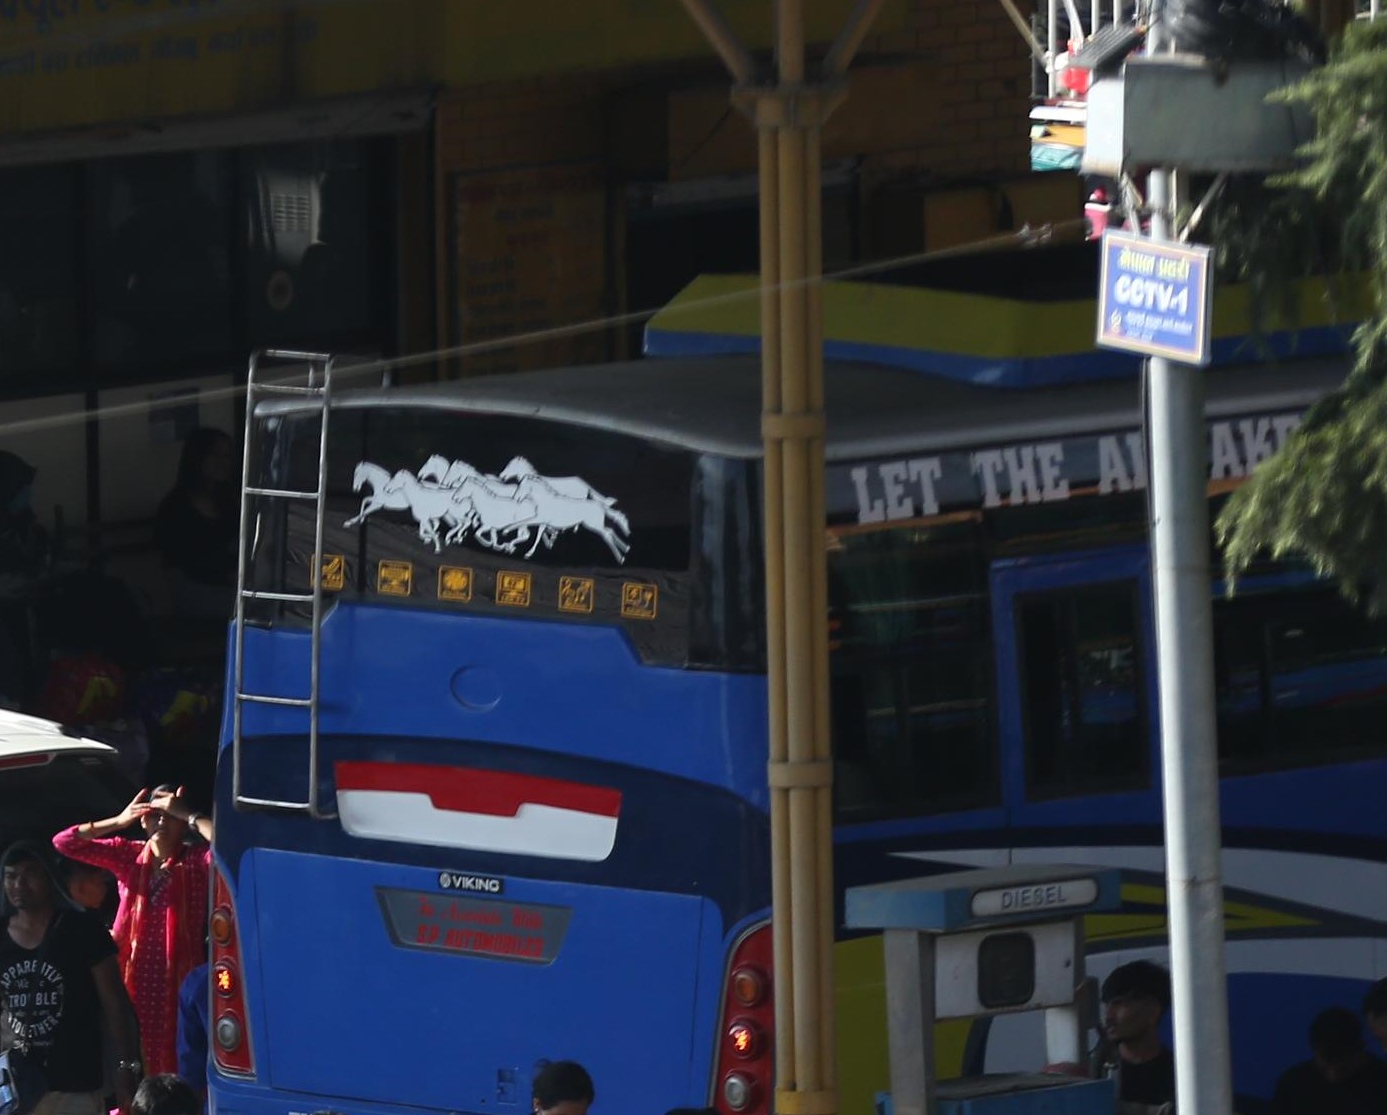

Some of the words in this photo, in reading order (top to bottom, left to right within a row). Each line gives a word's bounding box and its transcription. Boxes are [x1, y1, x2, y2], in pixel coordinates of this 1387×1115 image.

[1114, 275, 1189, 317] CCTV-1
[852, 458, 942, 525] LET
[973, 443, 1070, 506] THE
[452, 874, 500, 893] VIKING
[1001, 885, 1068, 910] DIESEL
[444, 929, 544, 957] AUTOMOBILES
[0, 959, 63, 988] APPARETLY
[9, 992, 59, 1008] TROBLE
